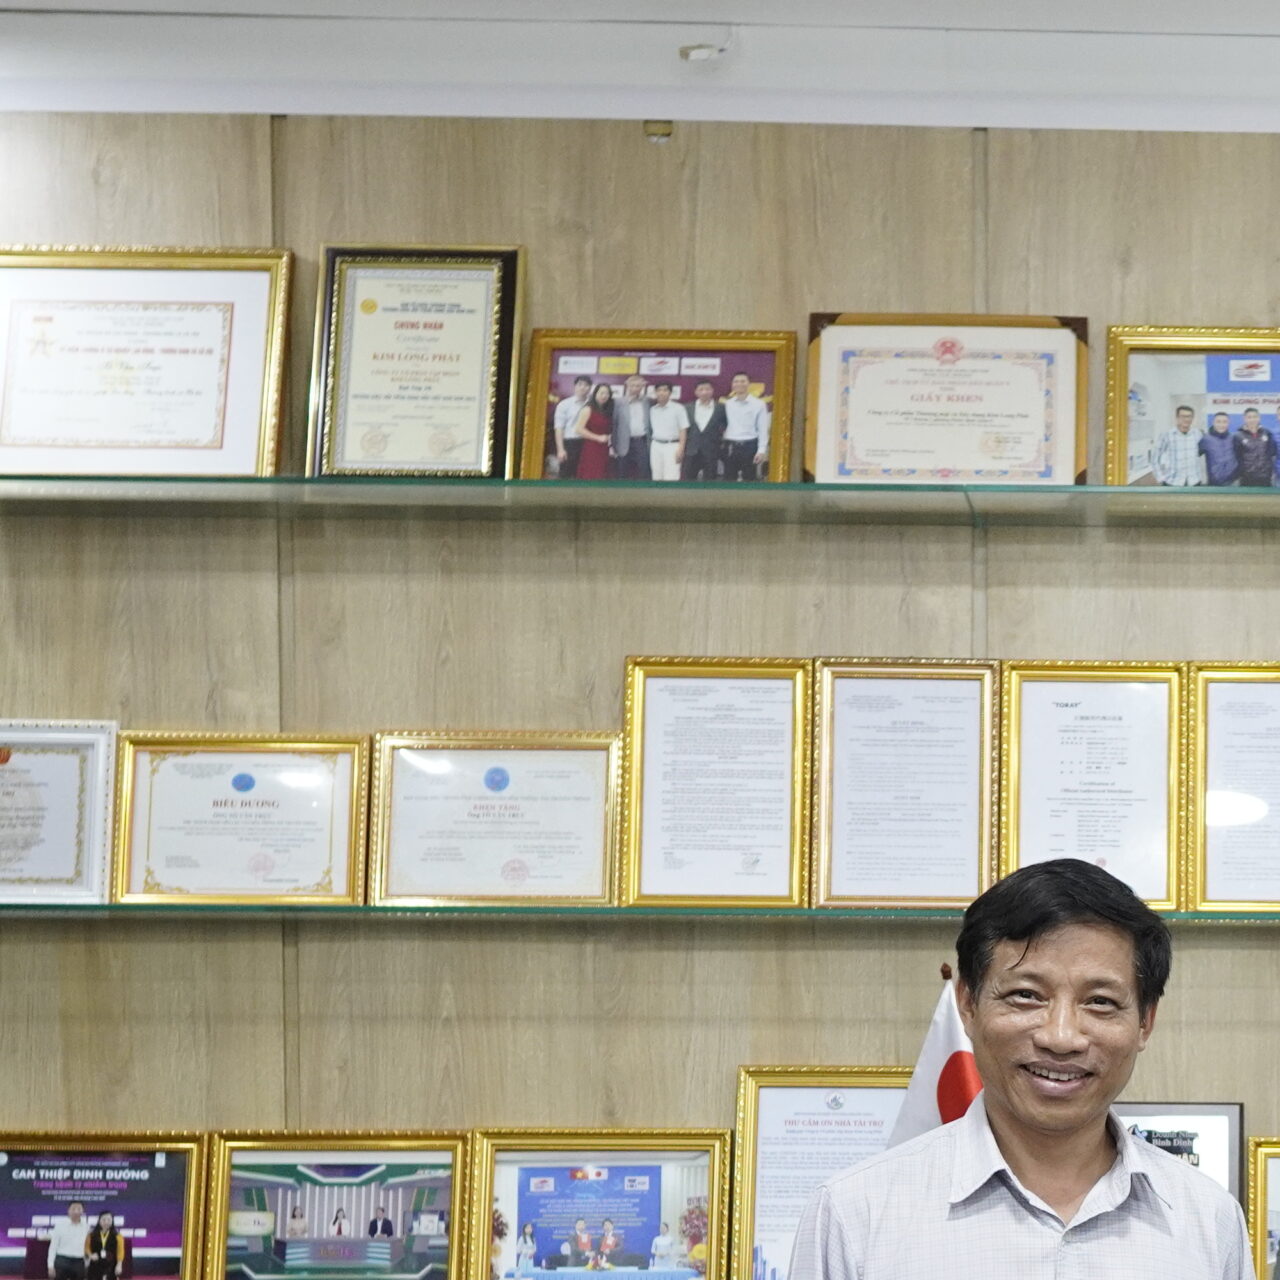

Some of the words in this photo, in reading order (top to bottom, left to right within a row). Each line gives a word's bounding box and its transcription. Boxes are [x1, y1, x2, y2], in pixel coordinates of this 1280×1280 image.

[12, 1168, 37, 1180] CAN
[38, 1167, 71, 1180] THIỆP
[73, 1169, 103, 1180] DINH
